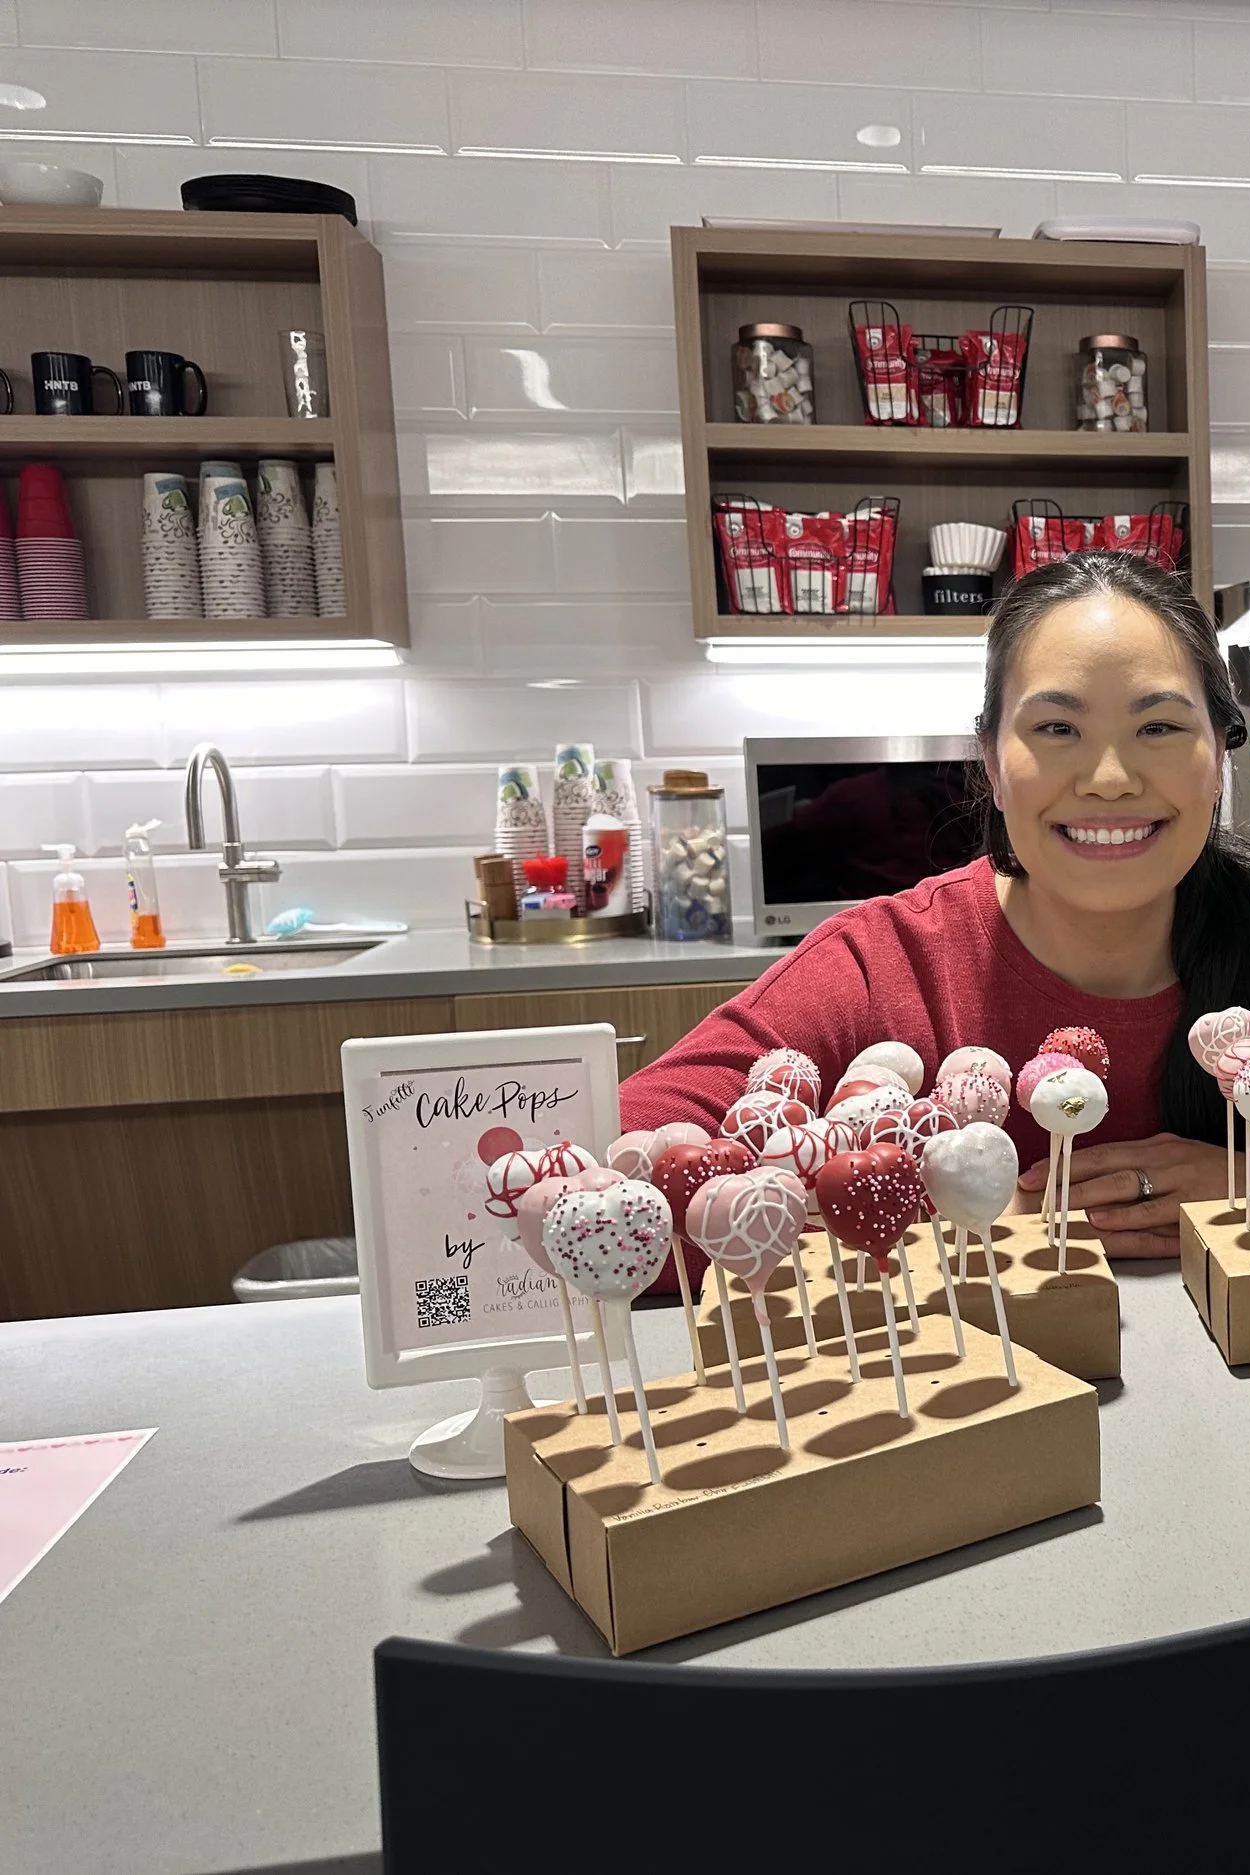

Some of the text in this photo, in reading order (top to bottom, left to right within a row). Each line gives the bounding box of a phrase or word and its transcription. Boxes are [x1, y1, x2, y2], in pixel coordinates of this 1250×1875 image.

[44, 380, 79, 391] HNTB
[933, 589, 984, 604] filters
[778, 915, 791, 925] LG
[362, 1079, 415, 1123] Funfetti
[416, 1076, 579, 1128] Cake Pops
[445, 1233, 486, 1270] by
[496, 1268, 557, 1298] radian
[483, 1297, 590, 1314] CAKES & CALLIGPHY
